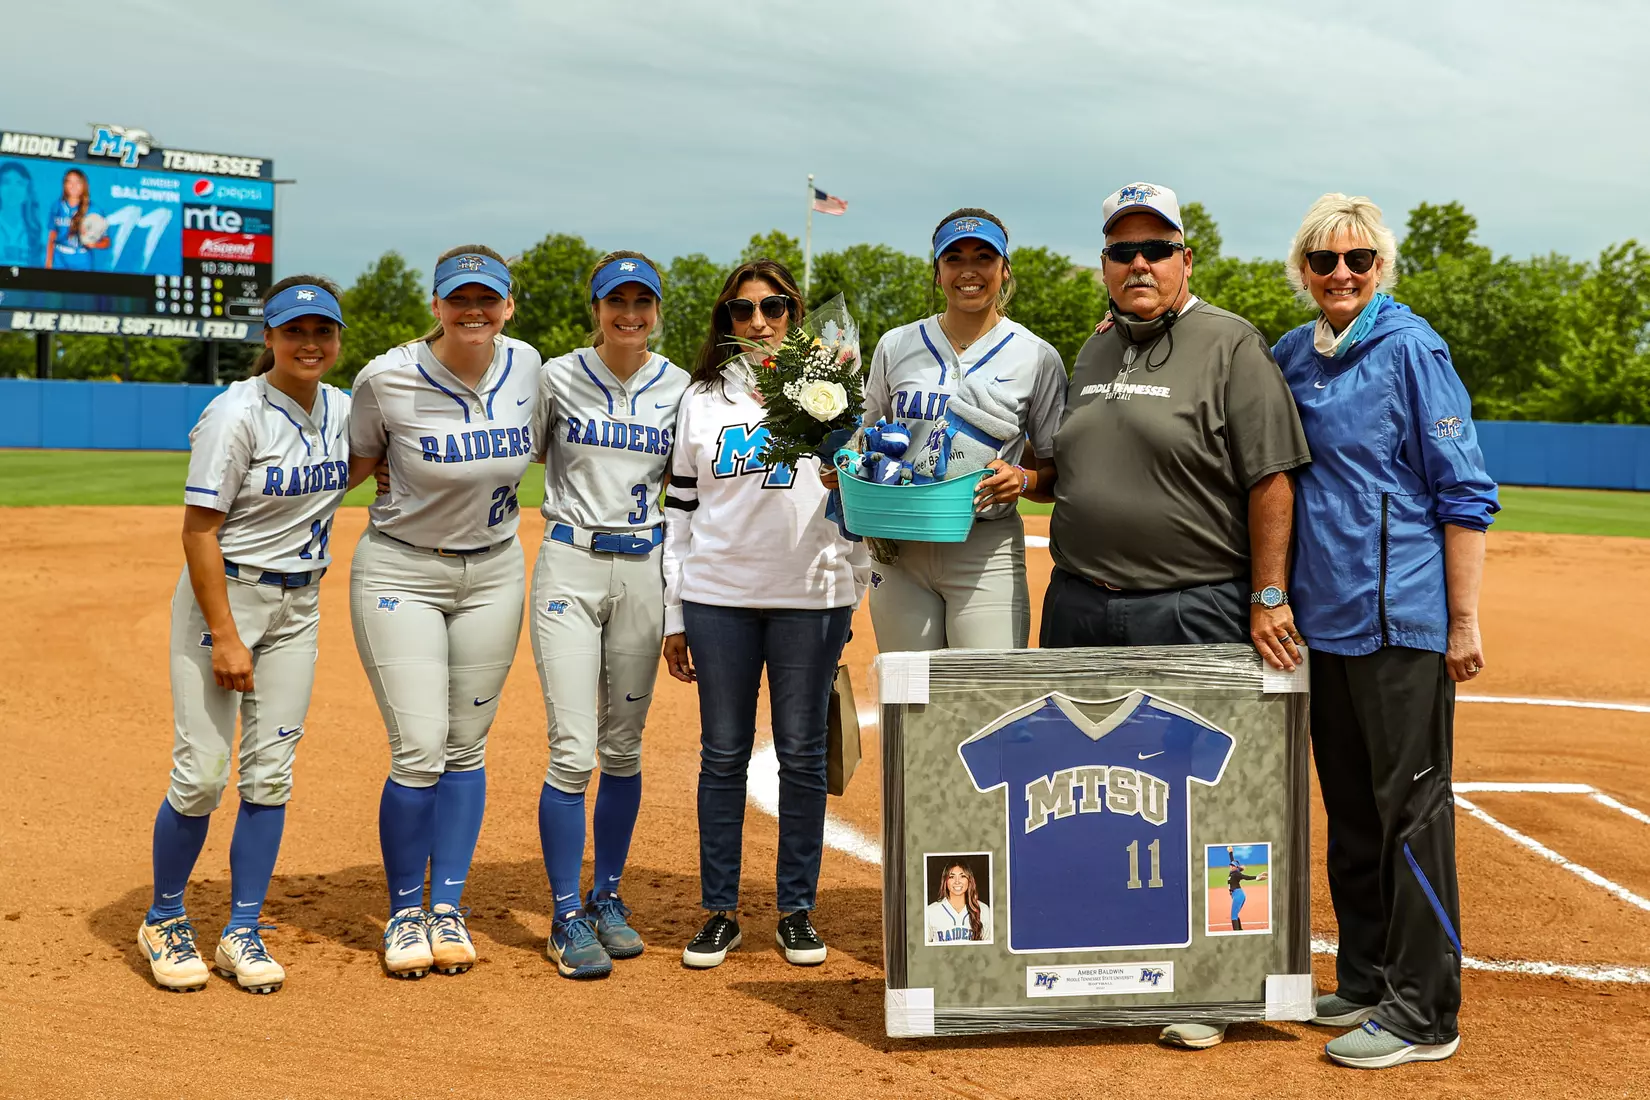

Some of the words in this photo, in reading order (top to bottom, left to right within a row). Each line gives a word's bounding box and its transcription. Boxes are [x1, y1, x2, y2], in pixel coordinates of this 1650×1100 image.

[0, 132, 78, 159] MIDDLE
[88, 125, 149, 168] MT
[162, 150, 263, 178] TENNESSEE
[110, 185, 180, 203] BALDWIN
[217, 185, 262, 201] pepsi
[184, 204, 242, 234] mte
[105, 204, 174, 272] 11
[200, 238, 255, 256] Ascend
[235, 263, 256, 277] AM
[10, 311, 59, 331] BLUE
[58, 314, 120, 333] RAIDER
[120, 317, 200, 338] SOFTBALL
[201, 322, 249, 340] FIELD
[1080, 382, 1113, 396] MIDDLE
[1113, 382, 1171, 399] TENNESSEE
[419, 425, 532, 463] RAIDERS
[566, 416, 670, 456] RAIDERS
[628, 483, 648, 525] 3
[1024, 764, 1170, 835] MTSU
[1126, 838, 1164, 890] 11
[1034, 972, 1061, 991] MT
[1077, 969, 1098, 977] AMBER
[1098, 968, 1124, 976] BALDWIN
[1139, 968, 1167, 987] MT
